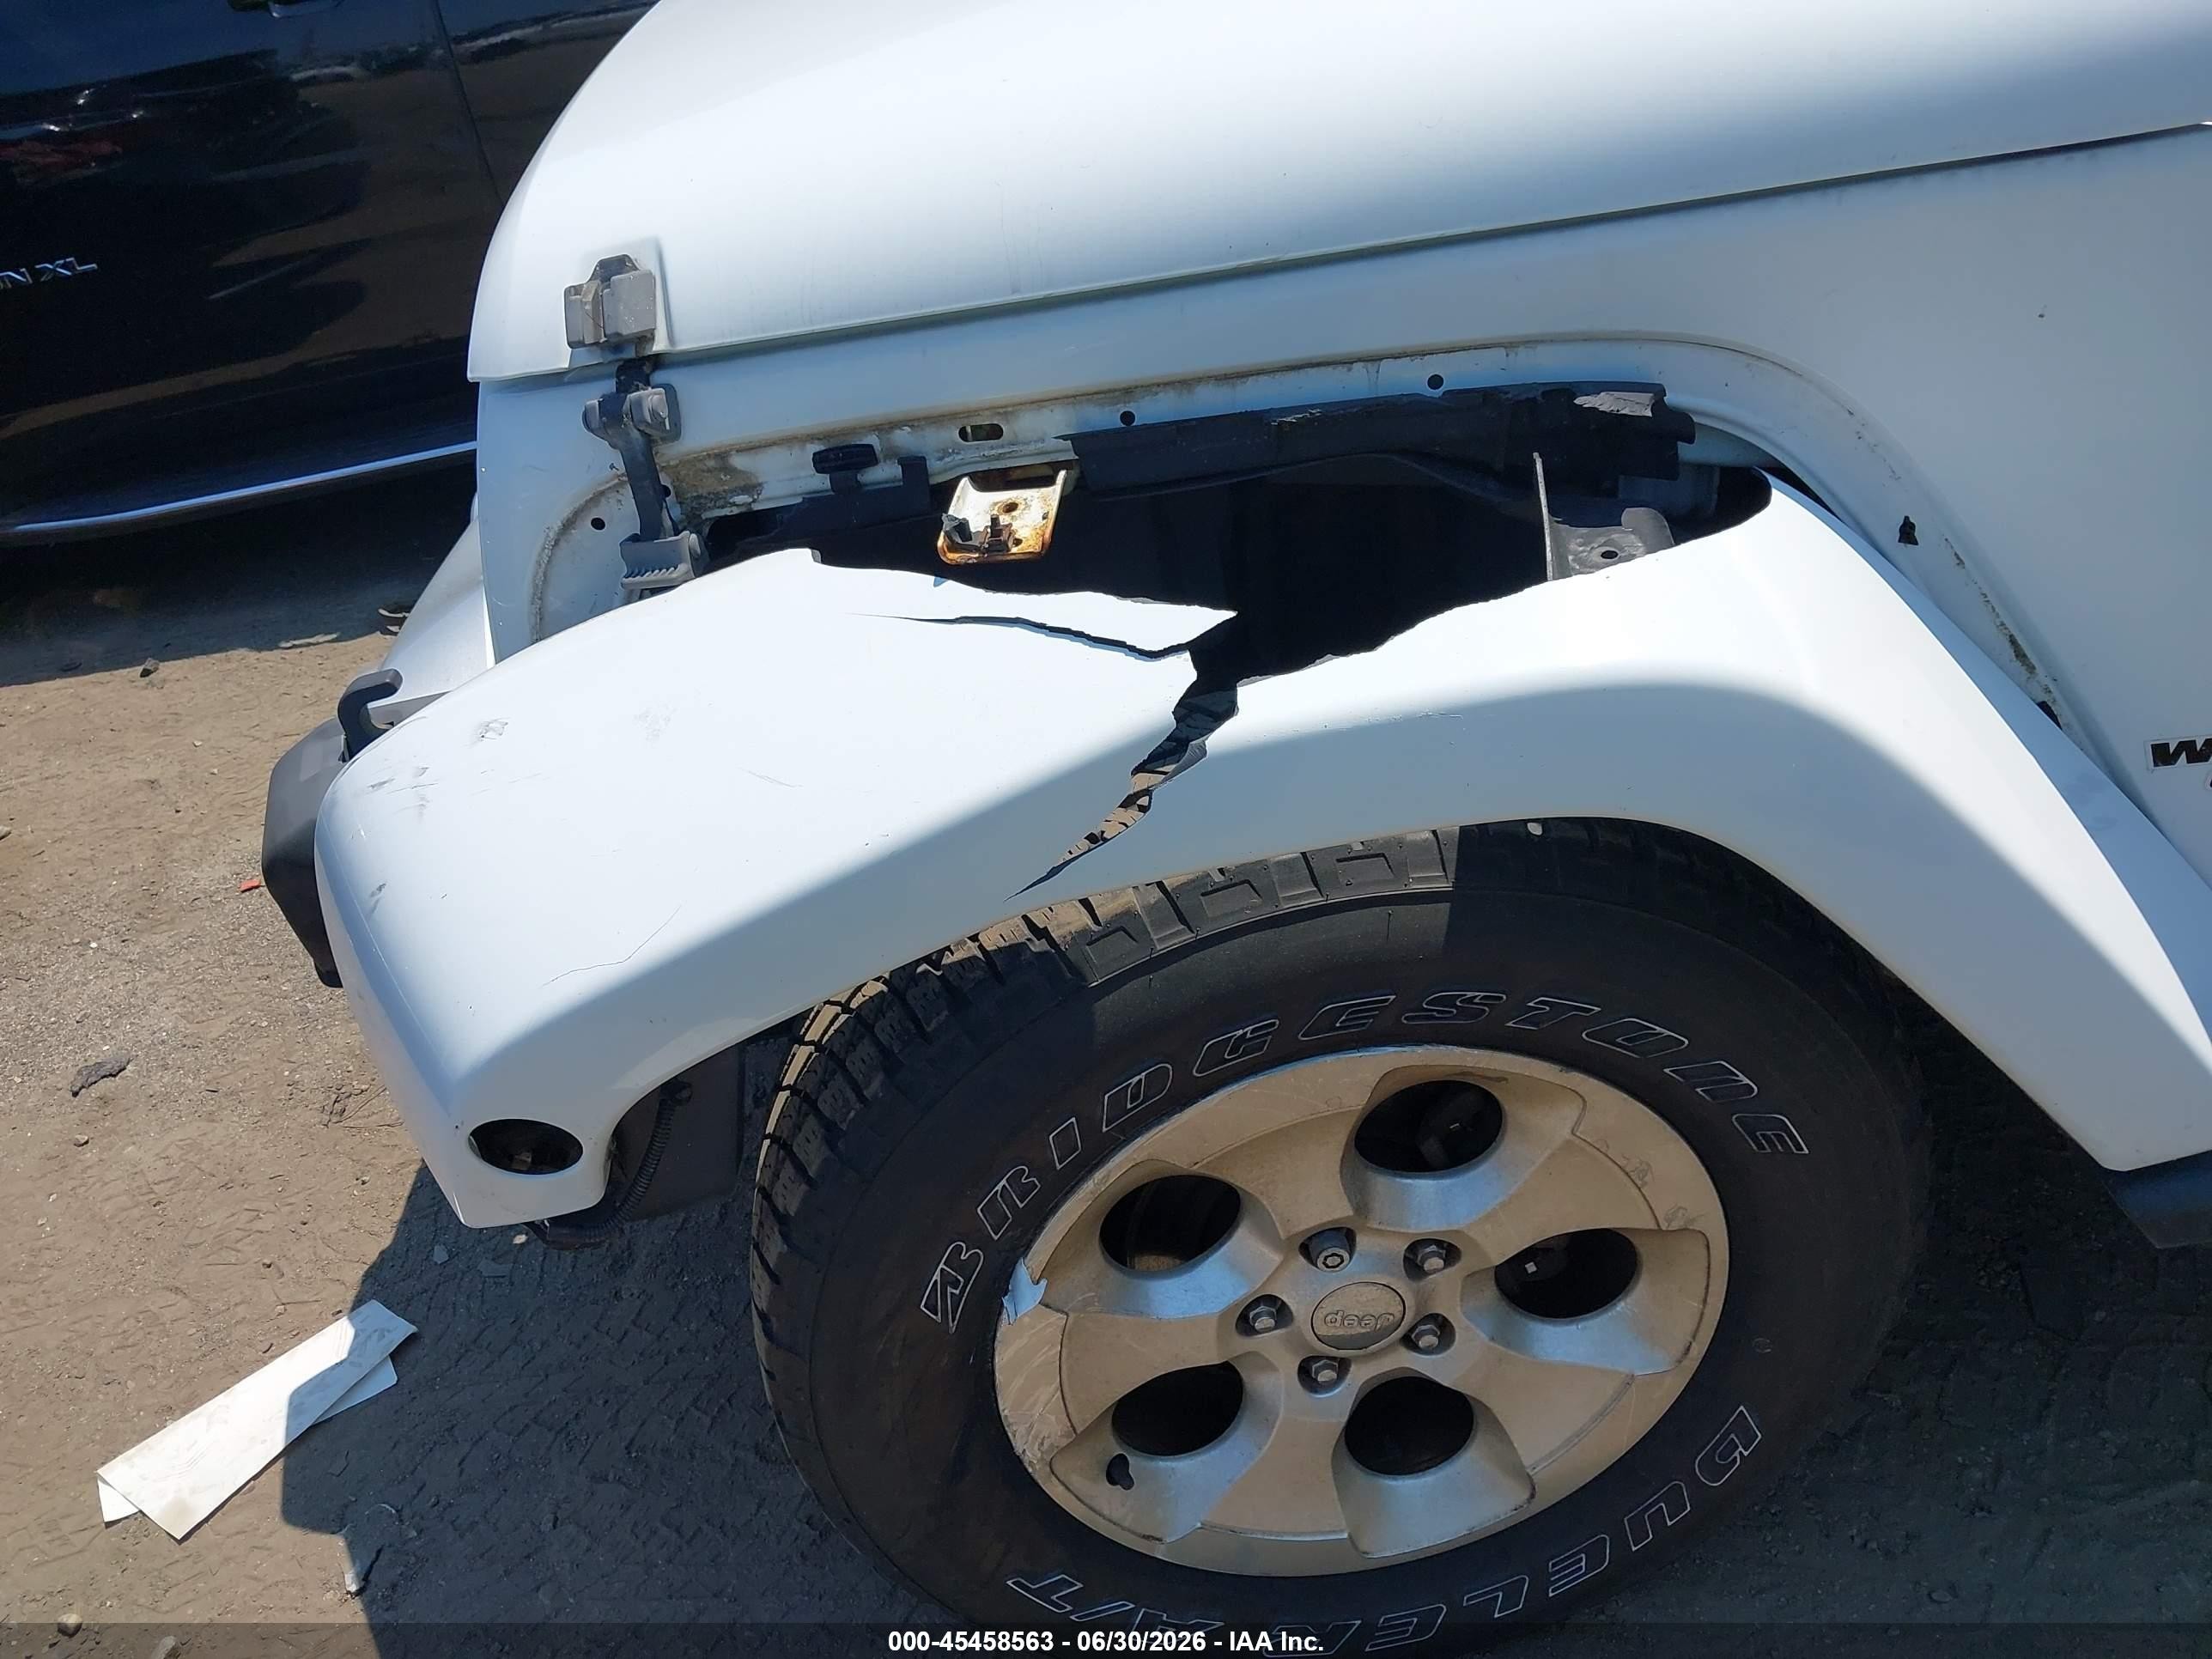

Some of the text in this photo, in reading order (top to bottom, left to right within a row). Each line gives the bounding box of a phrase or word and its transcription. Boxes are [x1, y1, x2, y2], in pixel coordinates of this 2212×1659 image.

[0, 258, 98, 289] N XL
[921, 992, 1809, 1334] BRIDGESTONE
[1006, 1406, 1762, 1658] DUELER A/T
